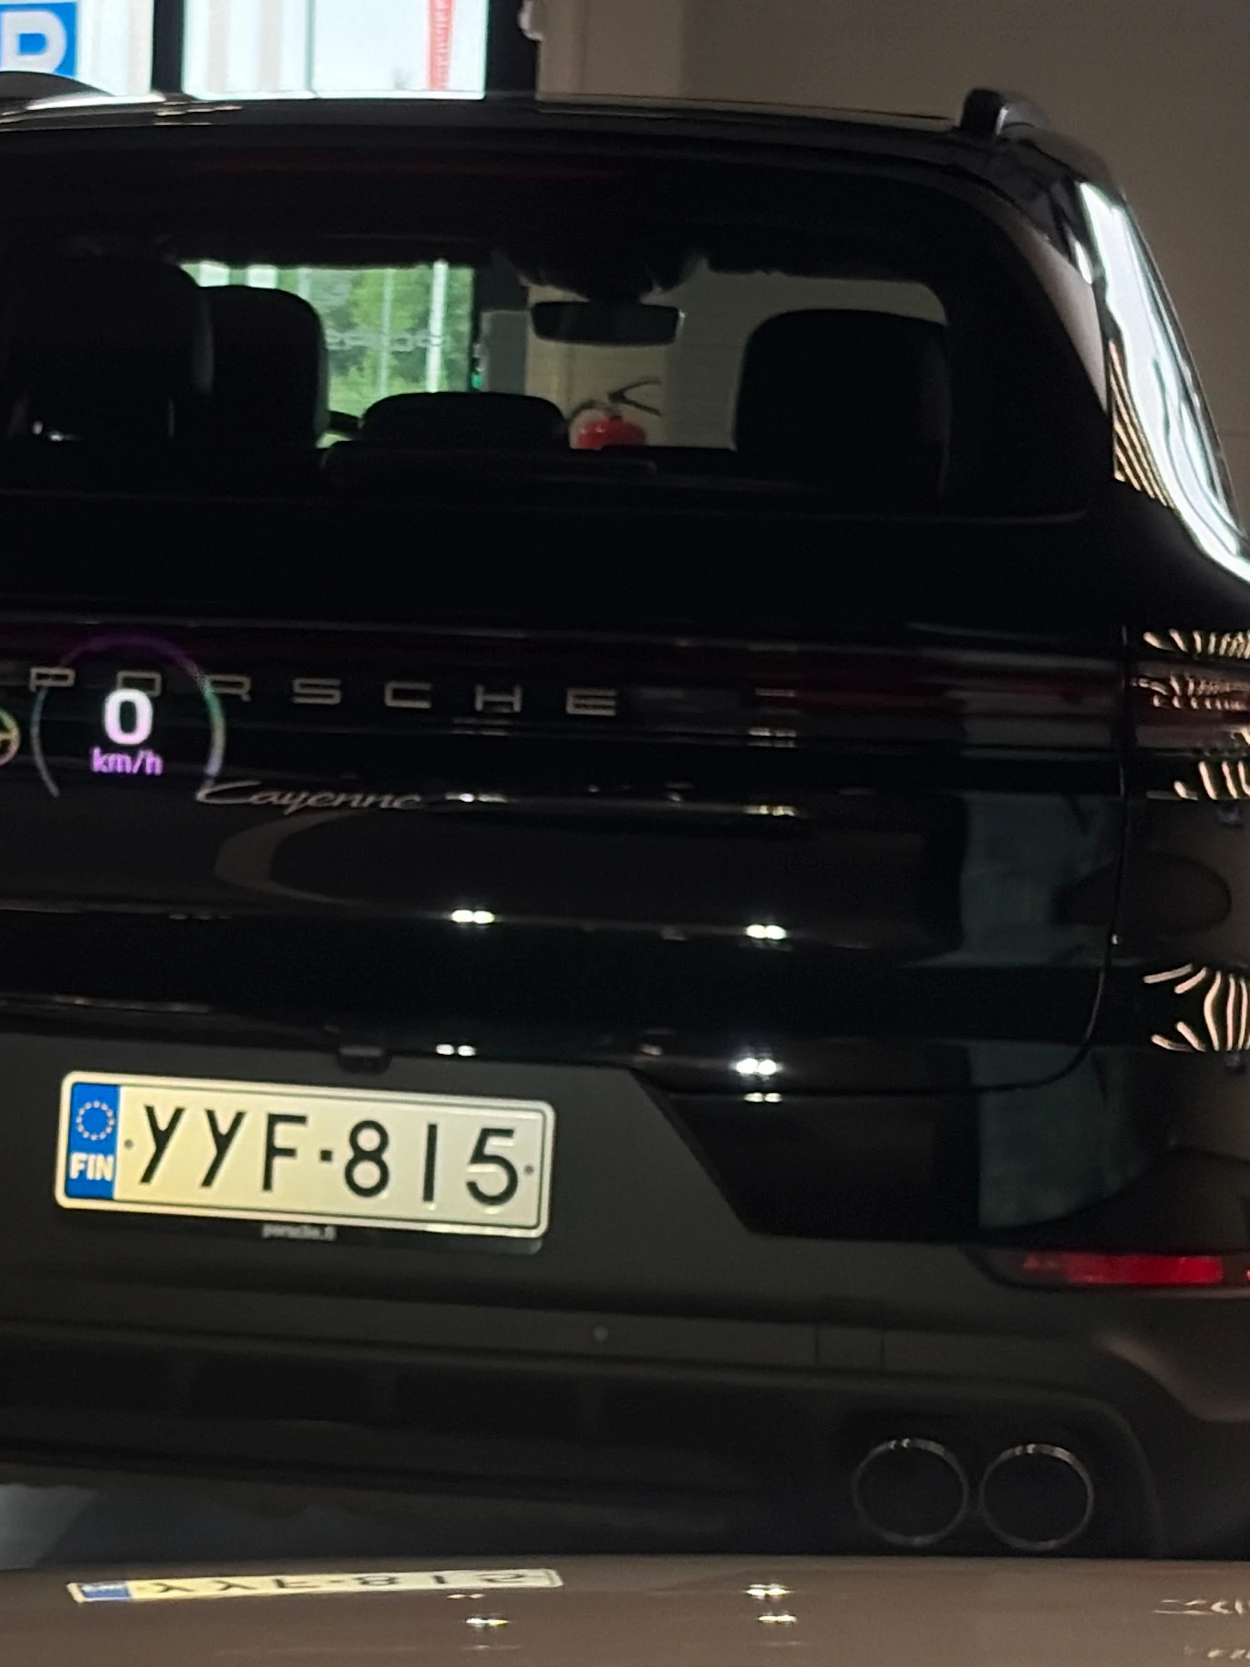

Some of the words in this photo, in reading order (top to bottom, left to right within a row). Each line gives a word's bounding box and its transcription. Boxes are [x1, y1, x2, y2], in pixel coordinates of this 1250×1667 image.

[0, 11, 67, 72] P
[30, 666, 618, 716] PORSCHE
[104, 688, 153, 745] 0
[90, 747, 163, 776] km/h
[196, 780, 426, 816] Cayenne
[69, 1152, 115, 1182] FIN
[139, 1105, 519, 1207] YYF-815
